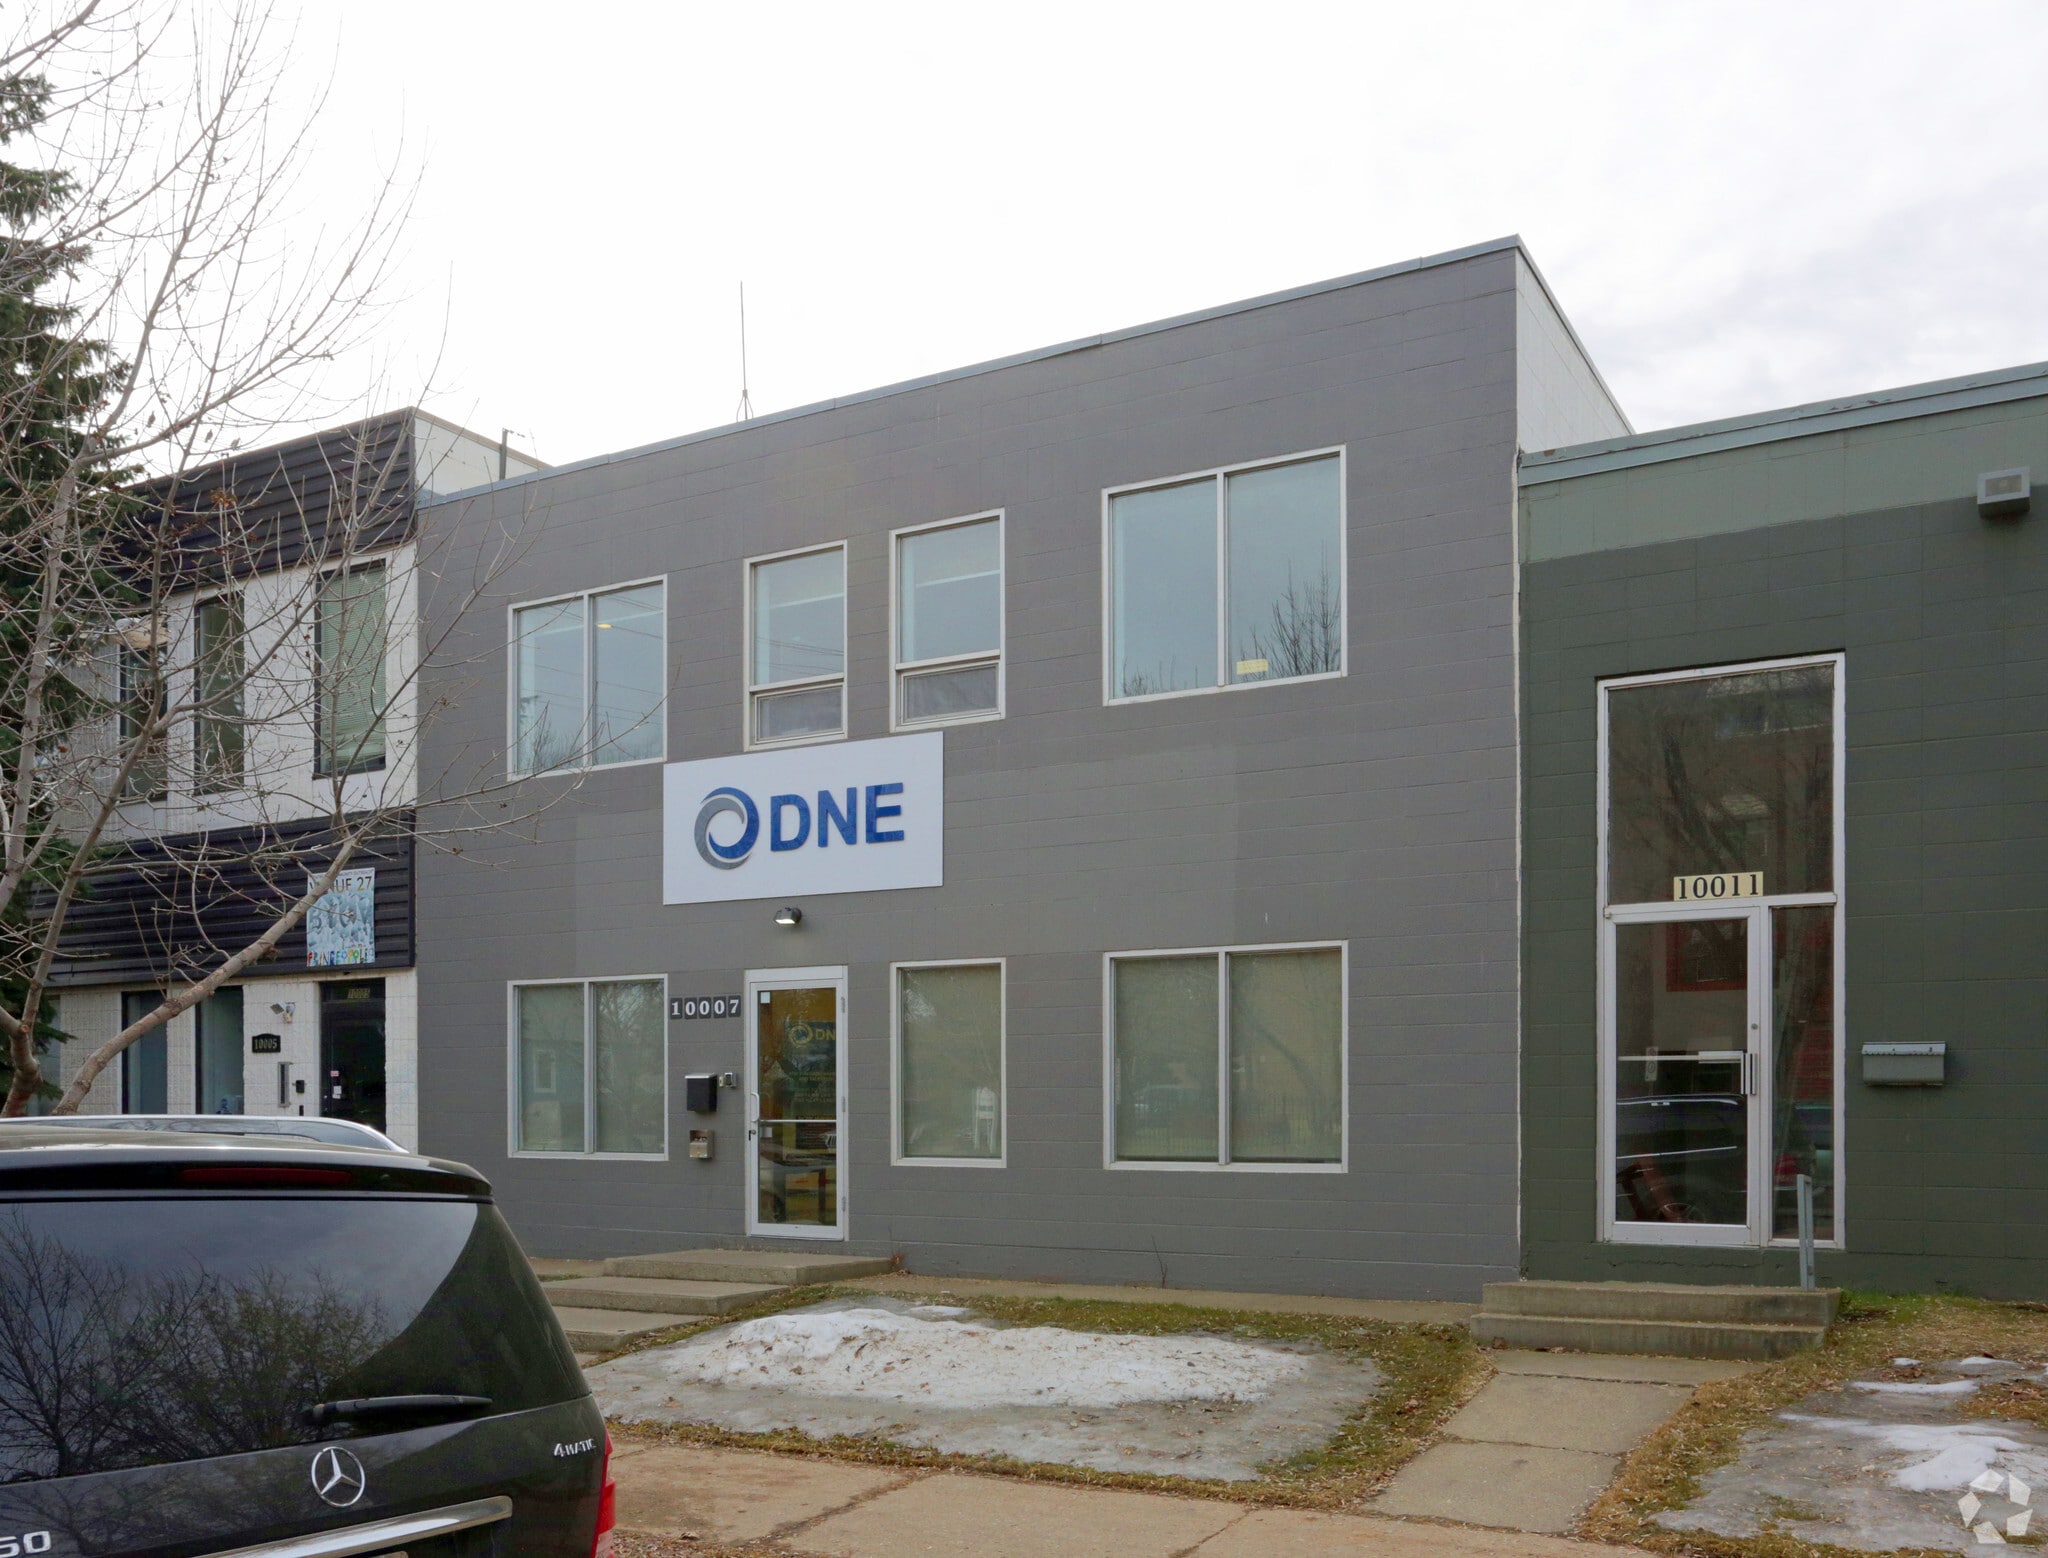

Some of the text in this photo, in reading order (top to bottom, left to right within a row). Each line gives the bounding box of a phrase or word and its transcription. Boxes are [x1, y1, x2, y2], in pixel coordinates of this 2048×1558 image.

[357, 876, 372, 891] 27
[1678, 873, 1760, 899] 10011
[671, 999, 740, 1017] 10007
[254, 1038, 278, 1050] 10005
